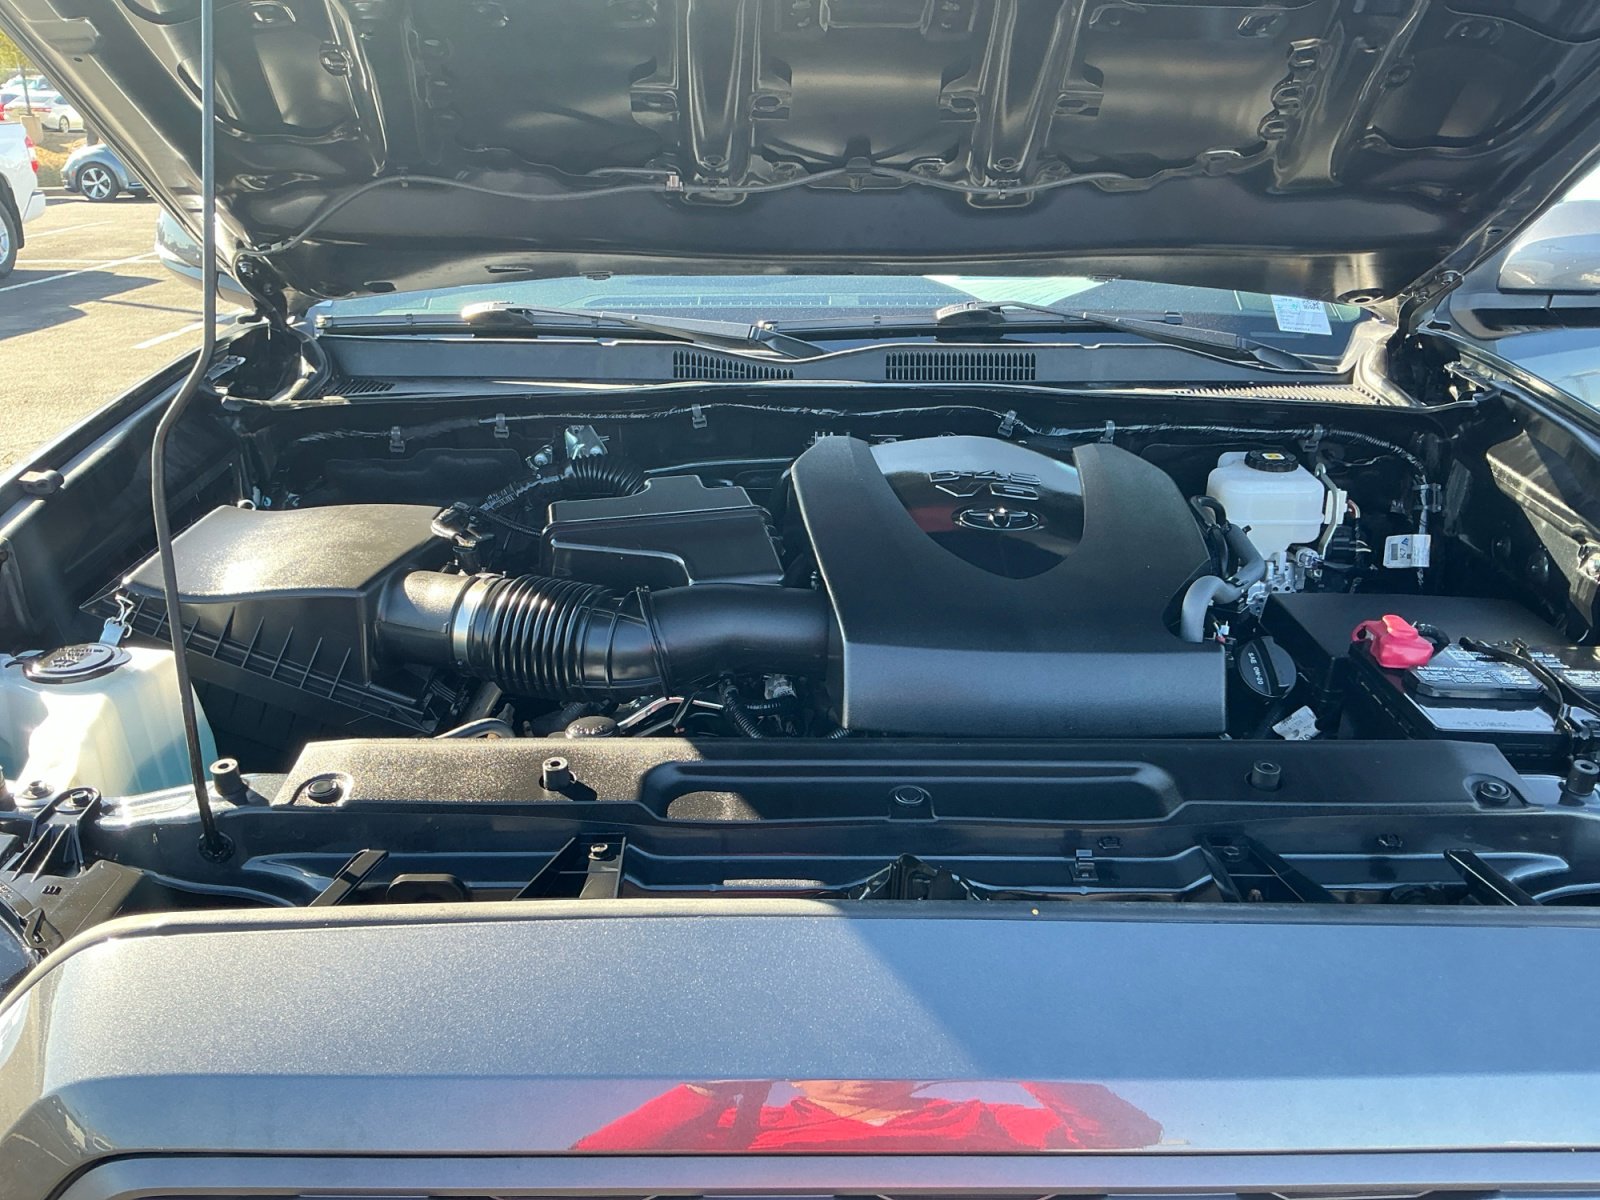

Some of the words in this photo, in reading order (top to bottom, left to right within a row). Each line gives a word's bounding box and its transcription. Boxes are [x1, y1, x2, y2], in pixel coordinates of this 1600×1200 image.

[934, 482, 1040, 500] V6
[1248, 652, 1257, 664] SAE
[1253, 666, 1264, 685] 0W-20
